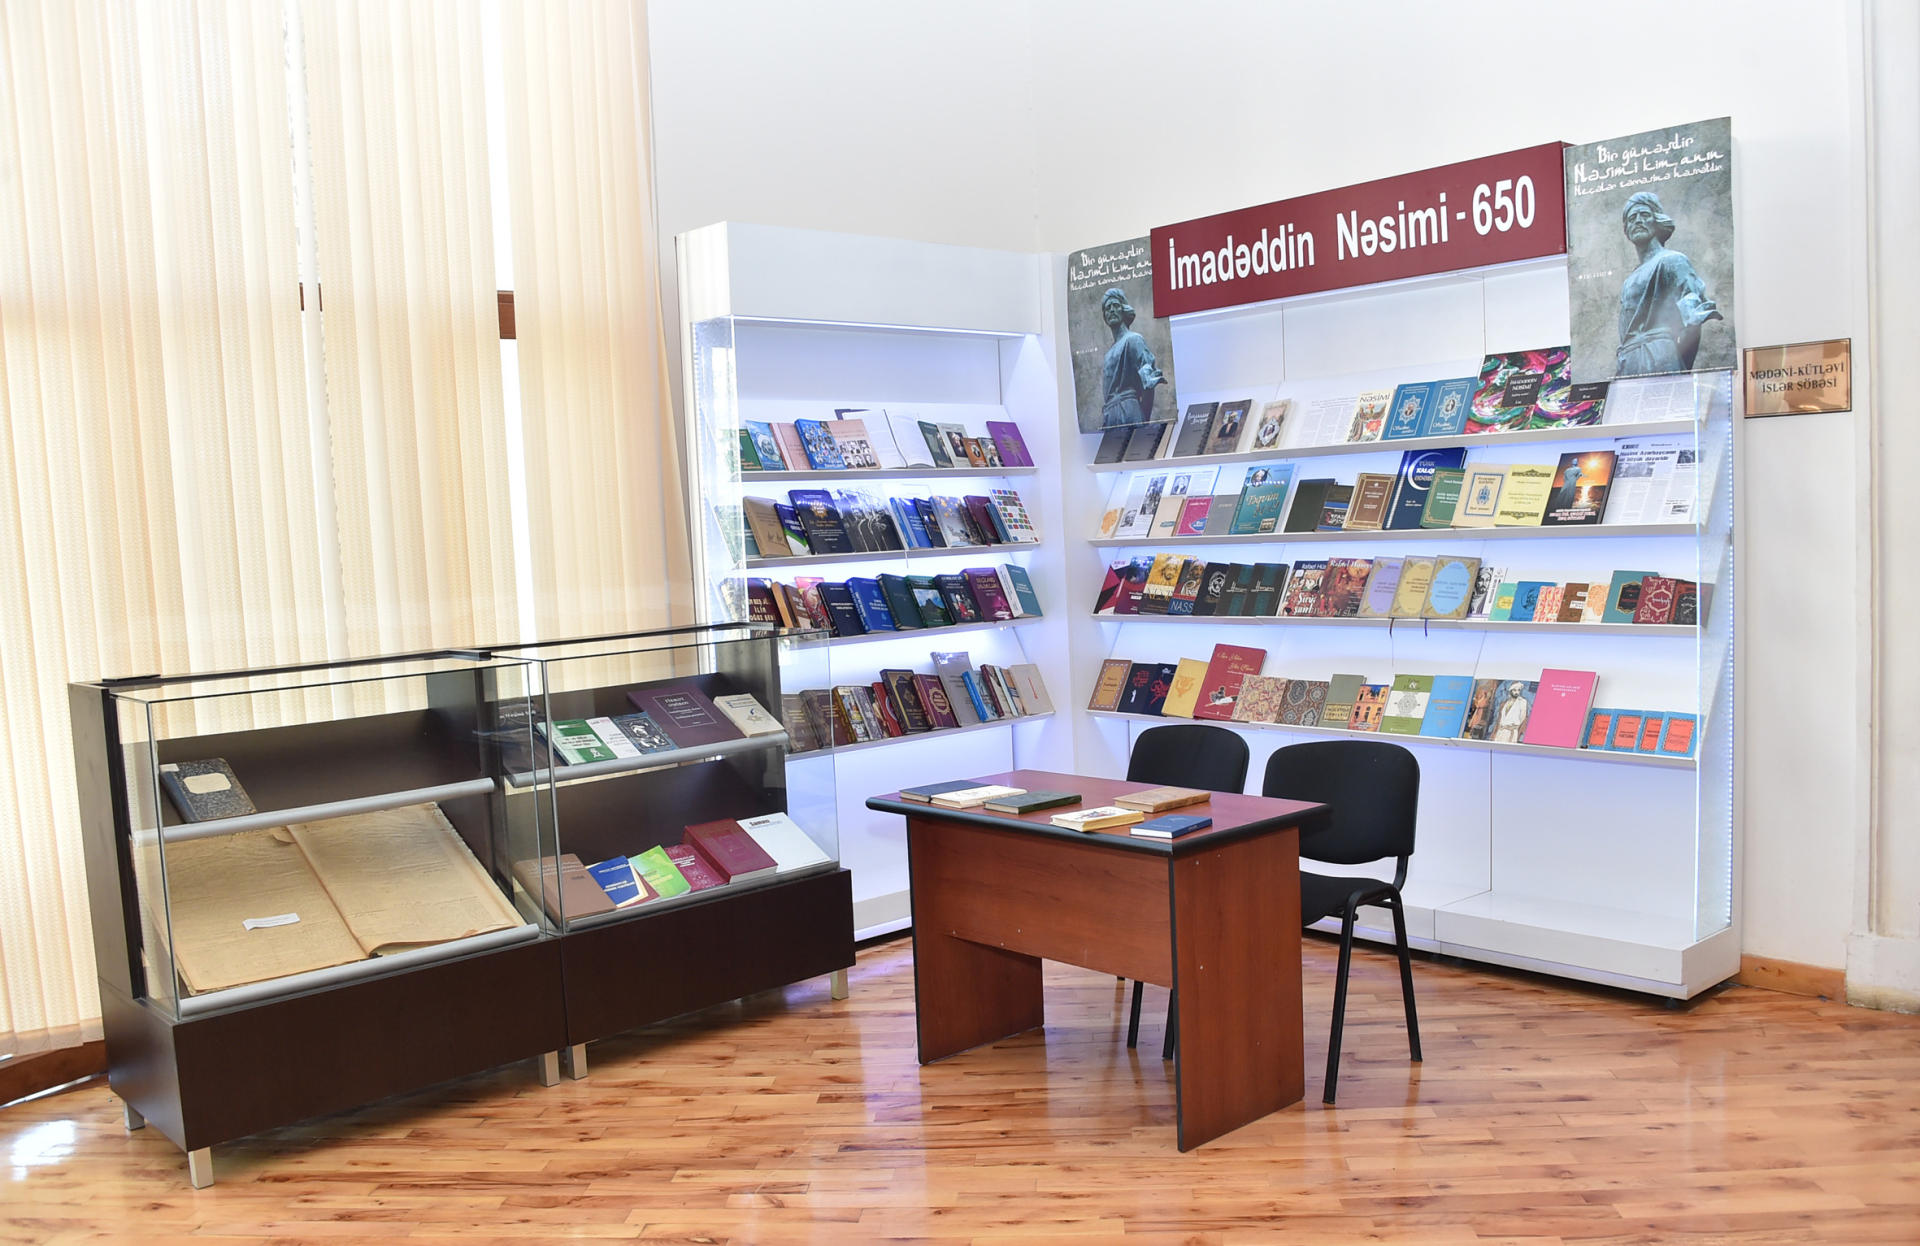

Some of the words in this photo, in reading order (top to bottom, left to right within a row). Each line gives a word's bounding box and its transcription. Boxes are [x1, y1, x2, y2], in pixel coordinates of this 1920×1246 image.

[1597, 144, 1618, 164] Bir
[1168, 223, 1315, 290] İmadəddin
[1336, 192, 1448, 261] Nəsimi
[1472, 175, 1535, 236] 650
